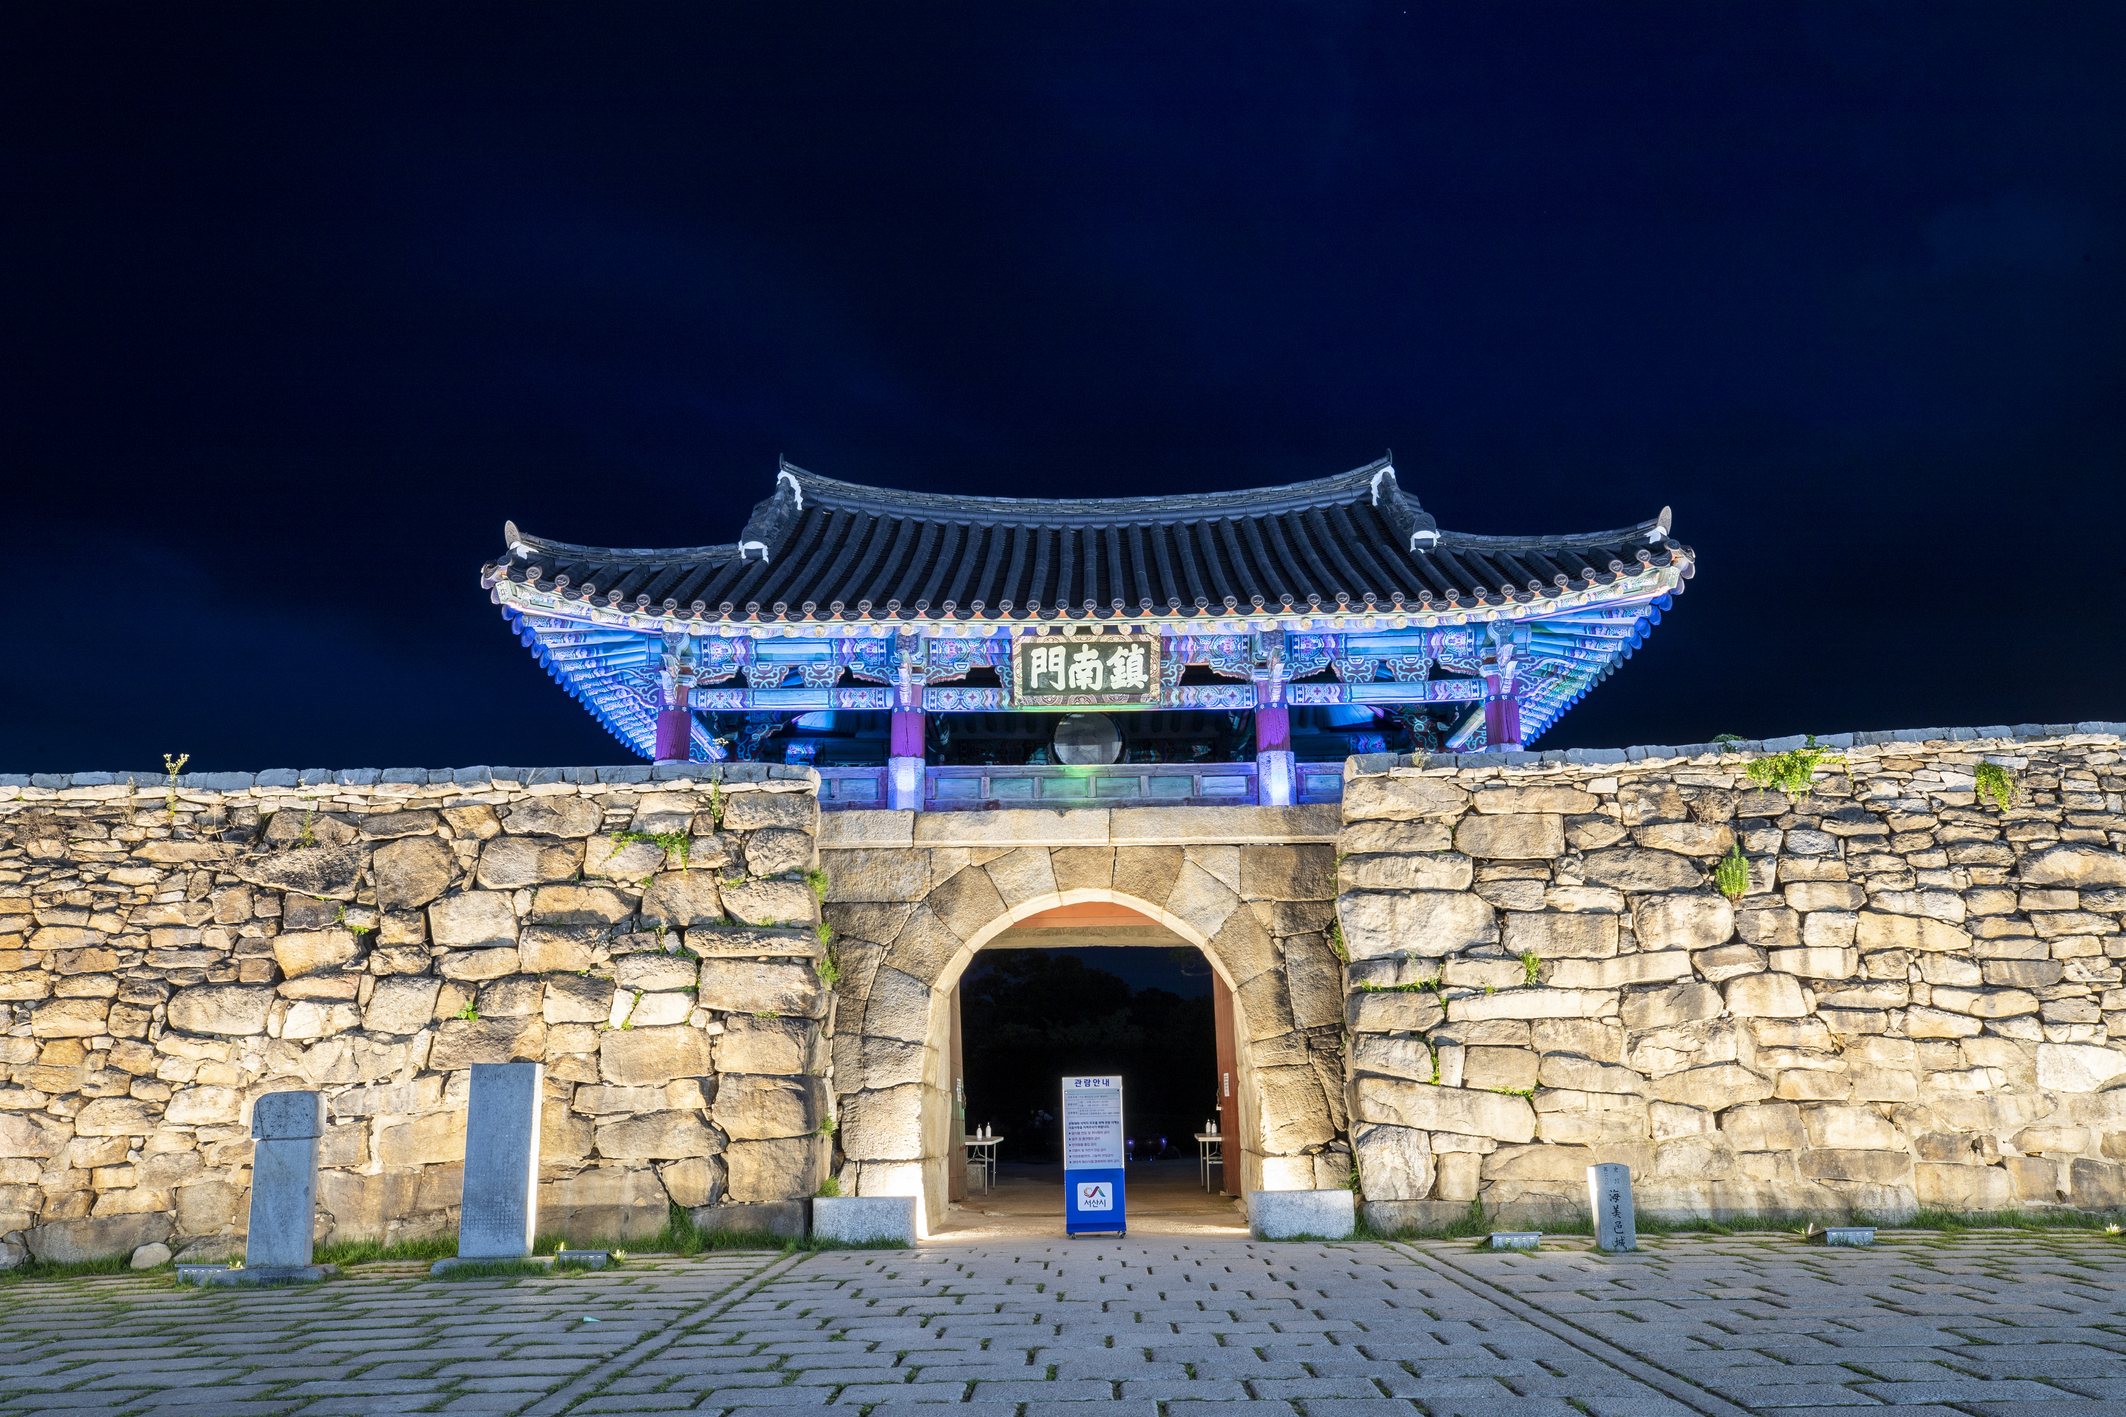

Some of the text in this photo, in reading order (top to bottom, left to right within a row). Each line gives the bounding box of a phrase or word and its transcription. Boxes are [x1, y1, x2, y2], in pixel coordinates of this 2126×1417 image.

[1083, 1199, 1107, 1208] 서산시
[1608, 1189, 1628, 1249] 海美邑城
